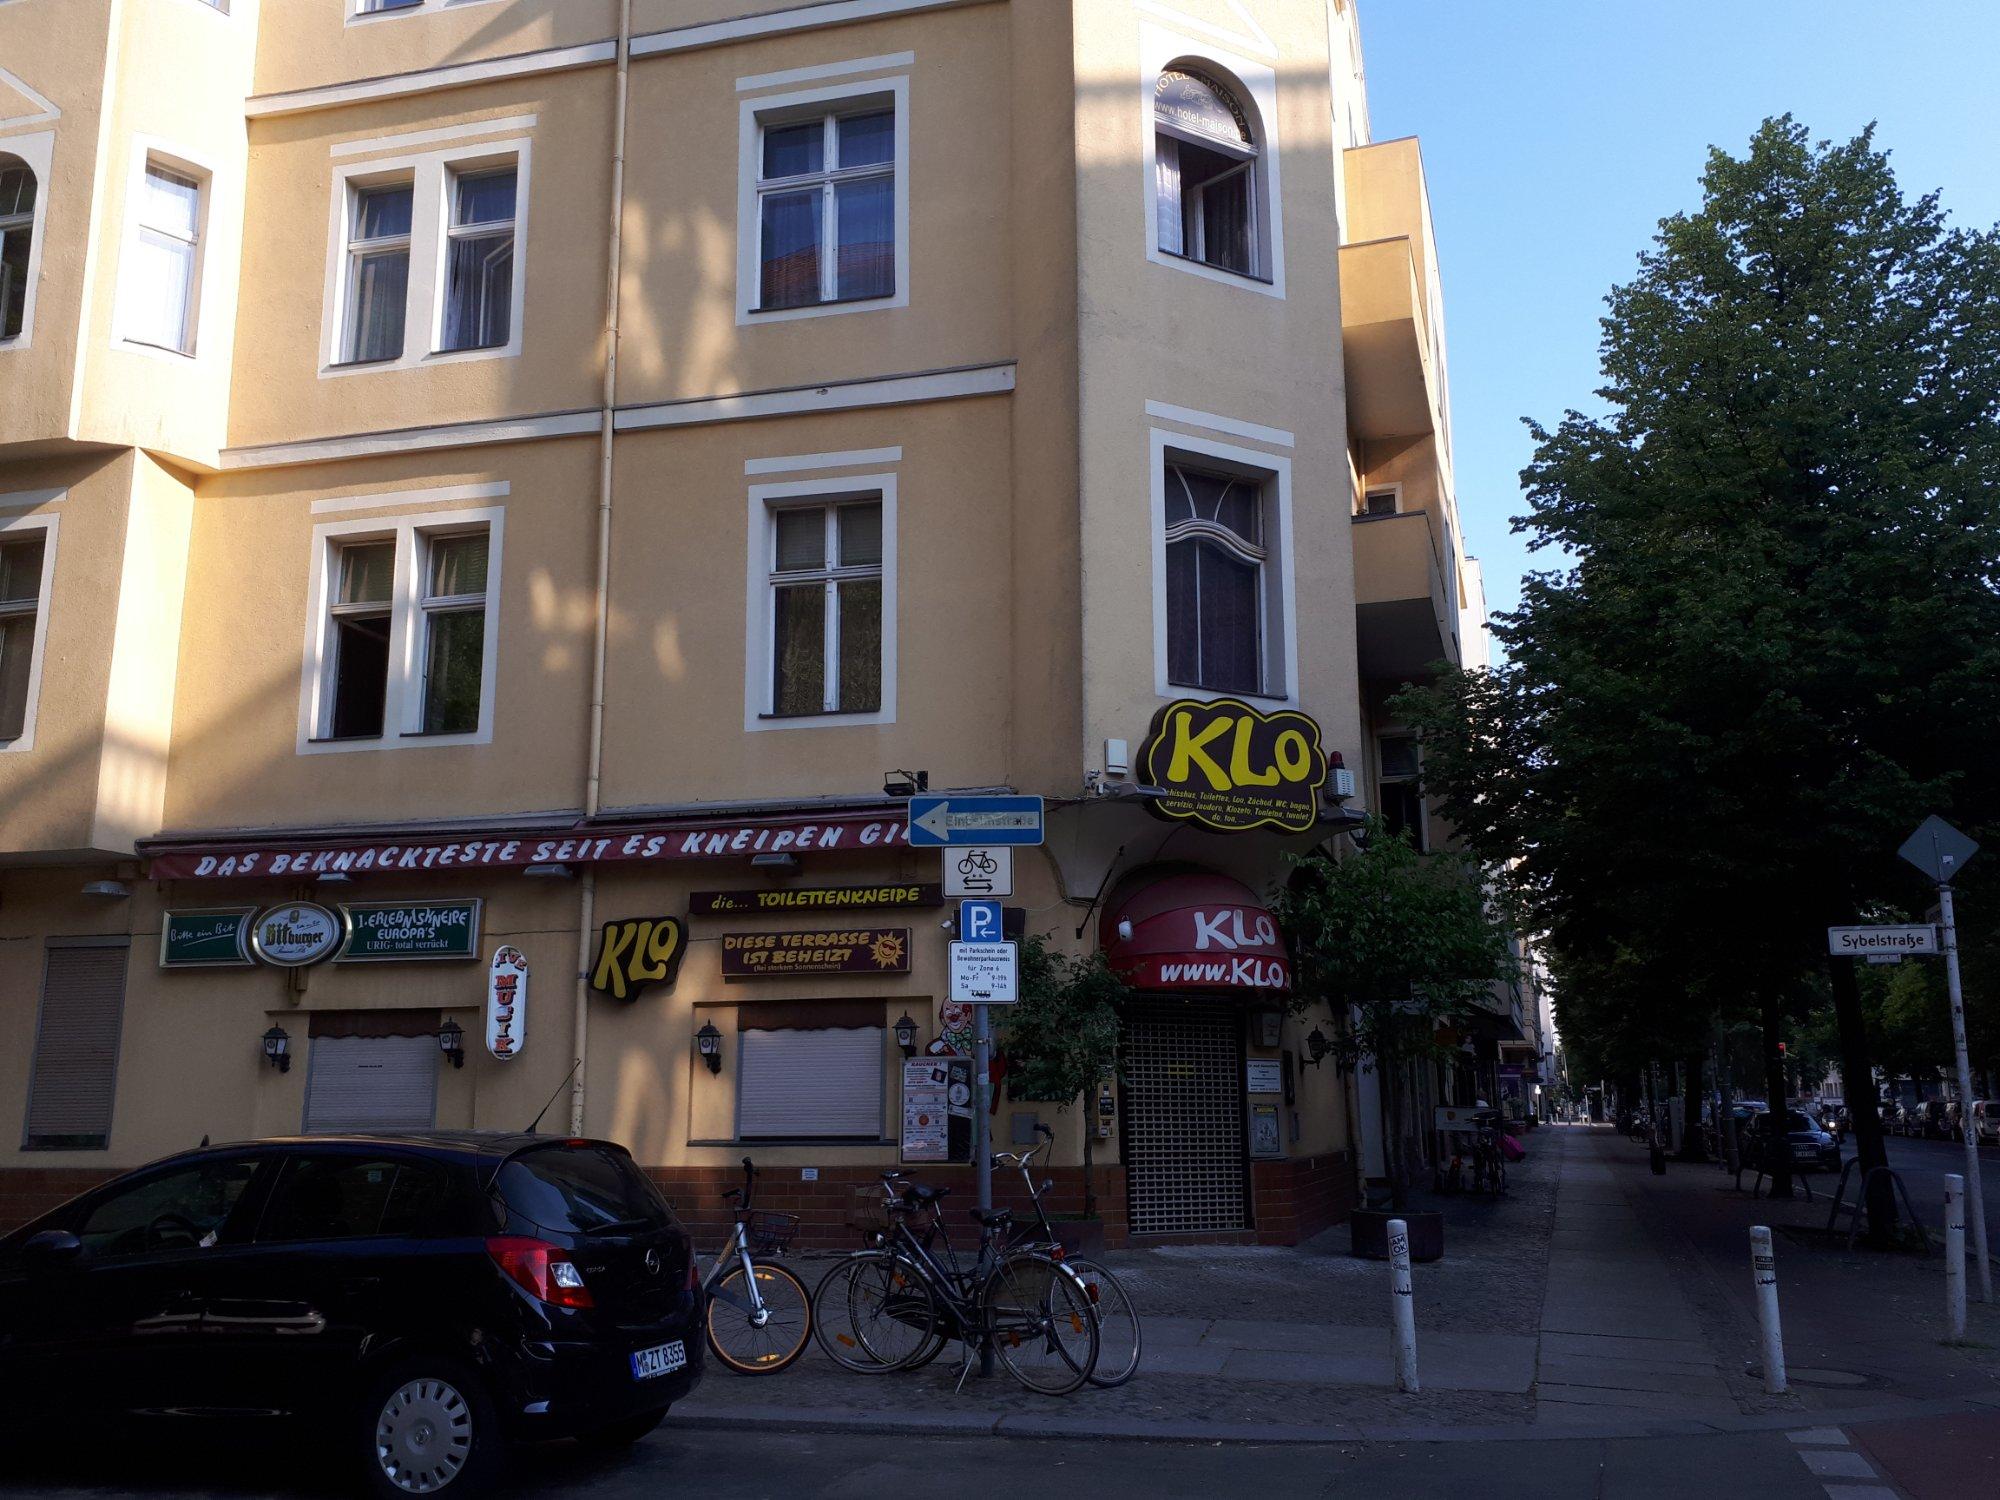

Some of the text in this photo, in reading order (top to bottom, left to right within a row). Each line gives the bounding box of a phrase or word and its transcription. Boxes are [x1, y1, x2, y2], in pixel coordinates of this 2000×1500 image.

[1154, 71, 1189, 97] HOTEL
[1167, 712, 1311, 791] KLO
[194, 852, 260, 877] DAS
[269, 841, 521, 875] BEKNACKTESTE
[531, 838, 612, 862] SEIT
[622, 834, 667, 857] ES
[679, 826, 844, 855] KNEIPEN
[757, 886, 920, 907] TOILETTENKNEIPE
[170, 922, 236, 942] Bitte ein Bit
[377, 927, 436, 940] EUROPA'S
[971, 906, 992, 938] P
[1193, 909, 1276, 950] KLO
[263, 922, 324, 948] Bitburger
[395, 940, 413, 949] total
[415, 939, 449, 949] verrückt
[724, 931, 871, 950] DIESE TERRASSE
[1842, 933, 1925, 949] Sybelstraße
[592, 920, 679, 998] KLO
[742, 948, 853, 965] IST BEHEIZT
[969, 946, 996, 954] Parkschein
[648, 1349, 661, 1371] ZT
[662, 1342, 685, 1366] 8355
